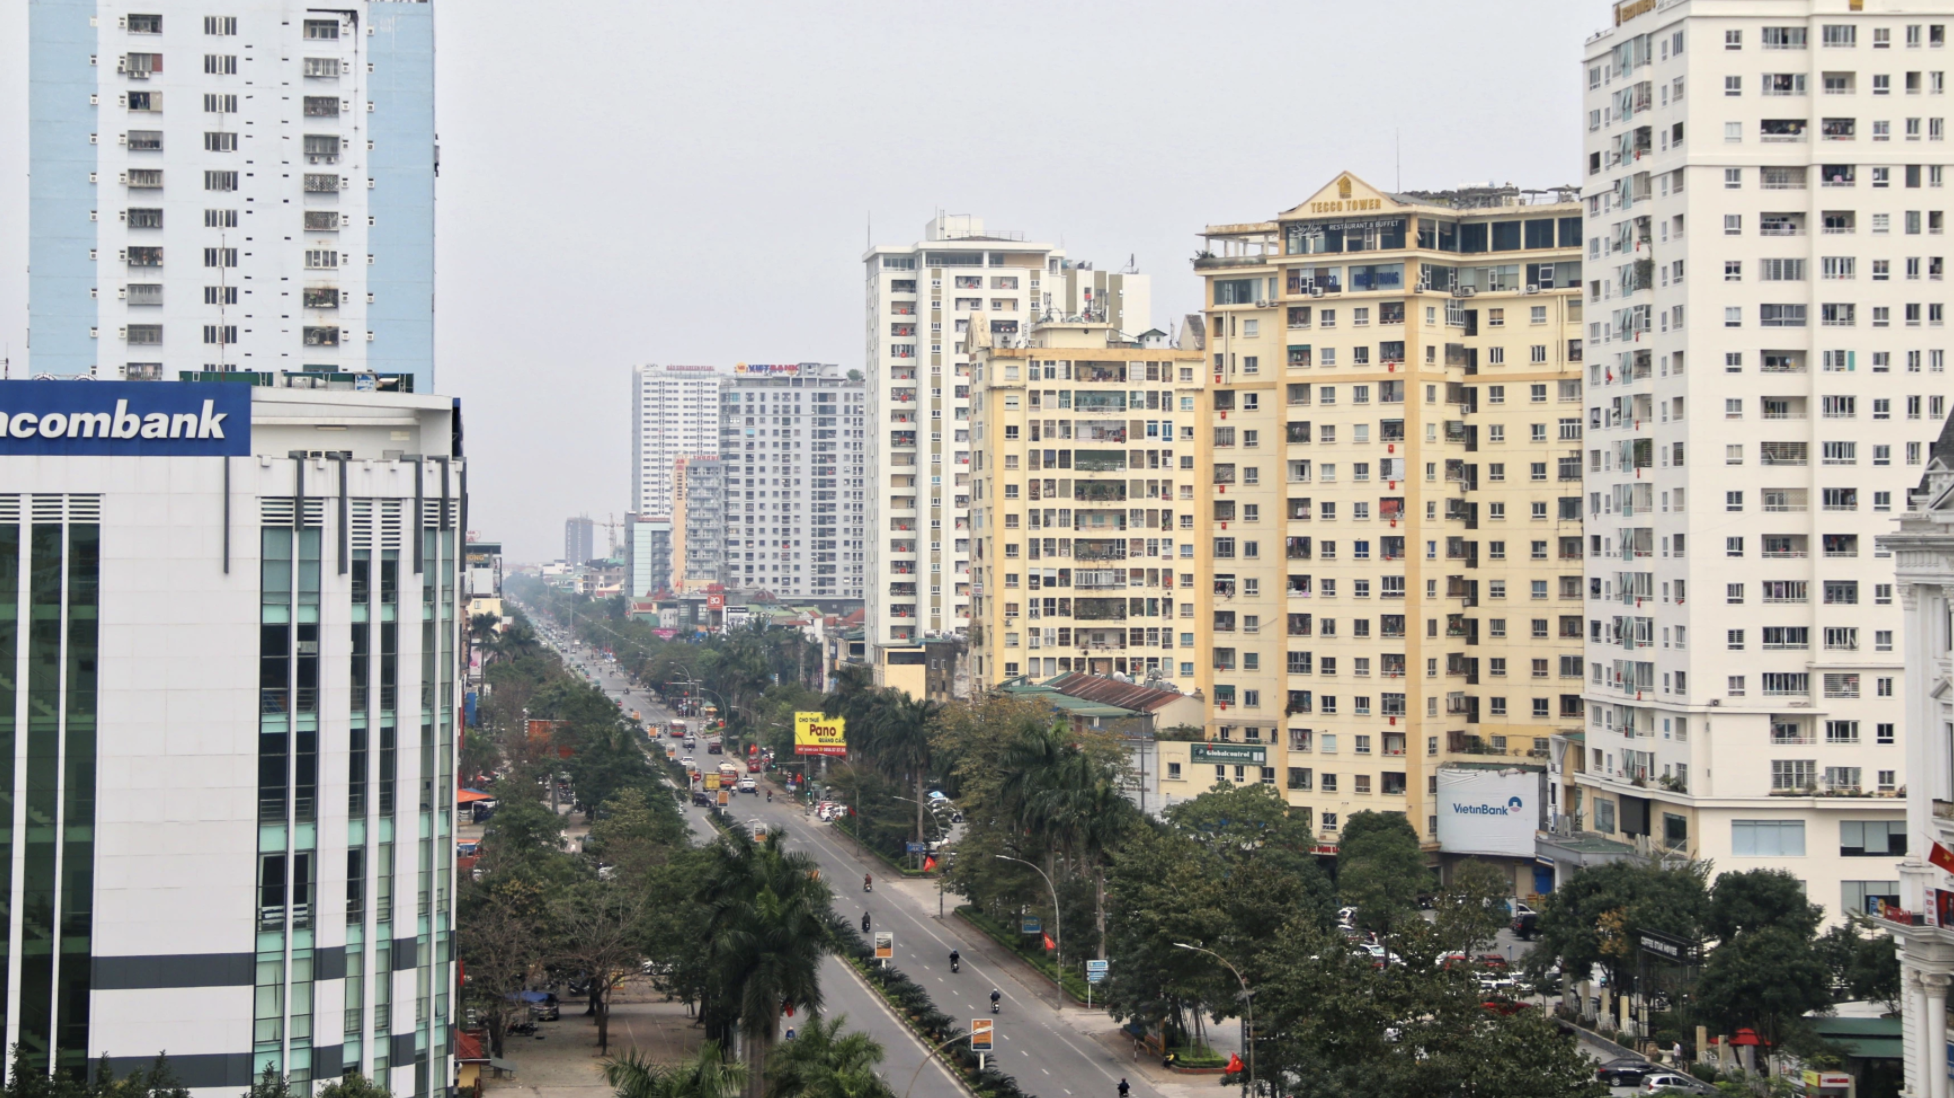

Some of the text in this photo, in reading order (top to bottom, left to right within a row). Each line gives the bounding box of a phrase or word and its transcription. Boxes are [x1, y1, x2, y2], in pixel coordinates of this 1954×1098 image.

[1311, 198, 1381, 213] TECCO TOWER
[1328, 222, 1367, 231] RESTAURANT
[1375, 220, 1399, 228] BUFFET
[810, 724, 836, 736] Pano
[1453, 803, 1508, 815] VietinBank
